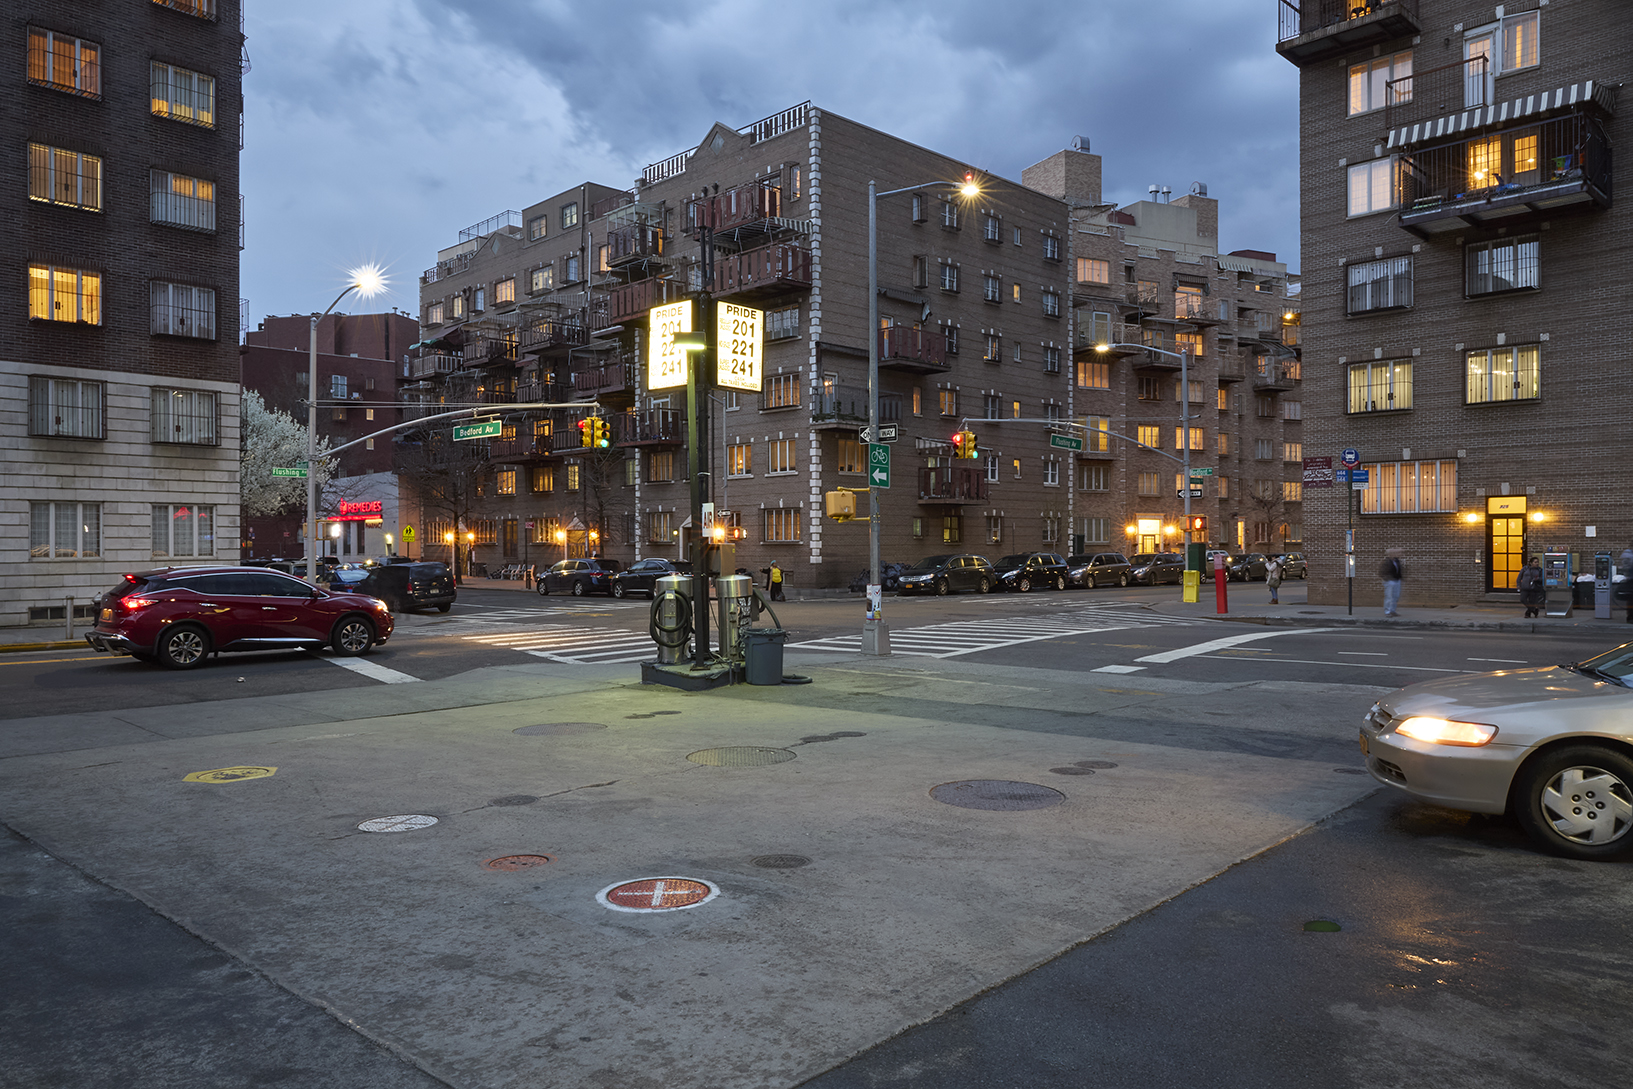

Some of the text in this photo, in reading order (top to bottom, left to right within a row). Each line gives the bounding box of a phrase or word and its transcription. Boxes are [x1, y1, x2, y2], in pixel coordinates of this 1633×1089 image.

[656, 306, 683, 320] PRIDE
[726, 304, 757, 320] PRIDE
[661, 320, 681, 337] 201
[732, 319, 755, 338] 201
[731, 339, 754, 358] 221
[661, 359, 682, 377] 241
[731, 358, 754, 377] 241
[460, 425, 494, 437] Bedford Av
[881, 429, 895, 437] WAY
[272, 468, 300, 478] Flushing
[347, 501, 382, 513] REMEDIES
[703, 511, 713, 529] AIR
